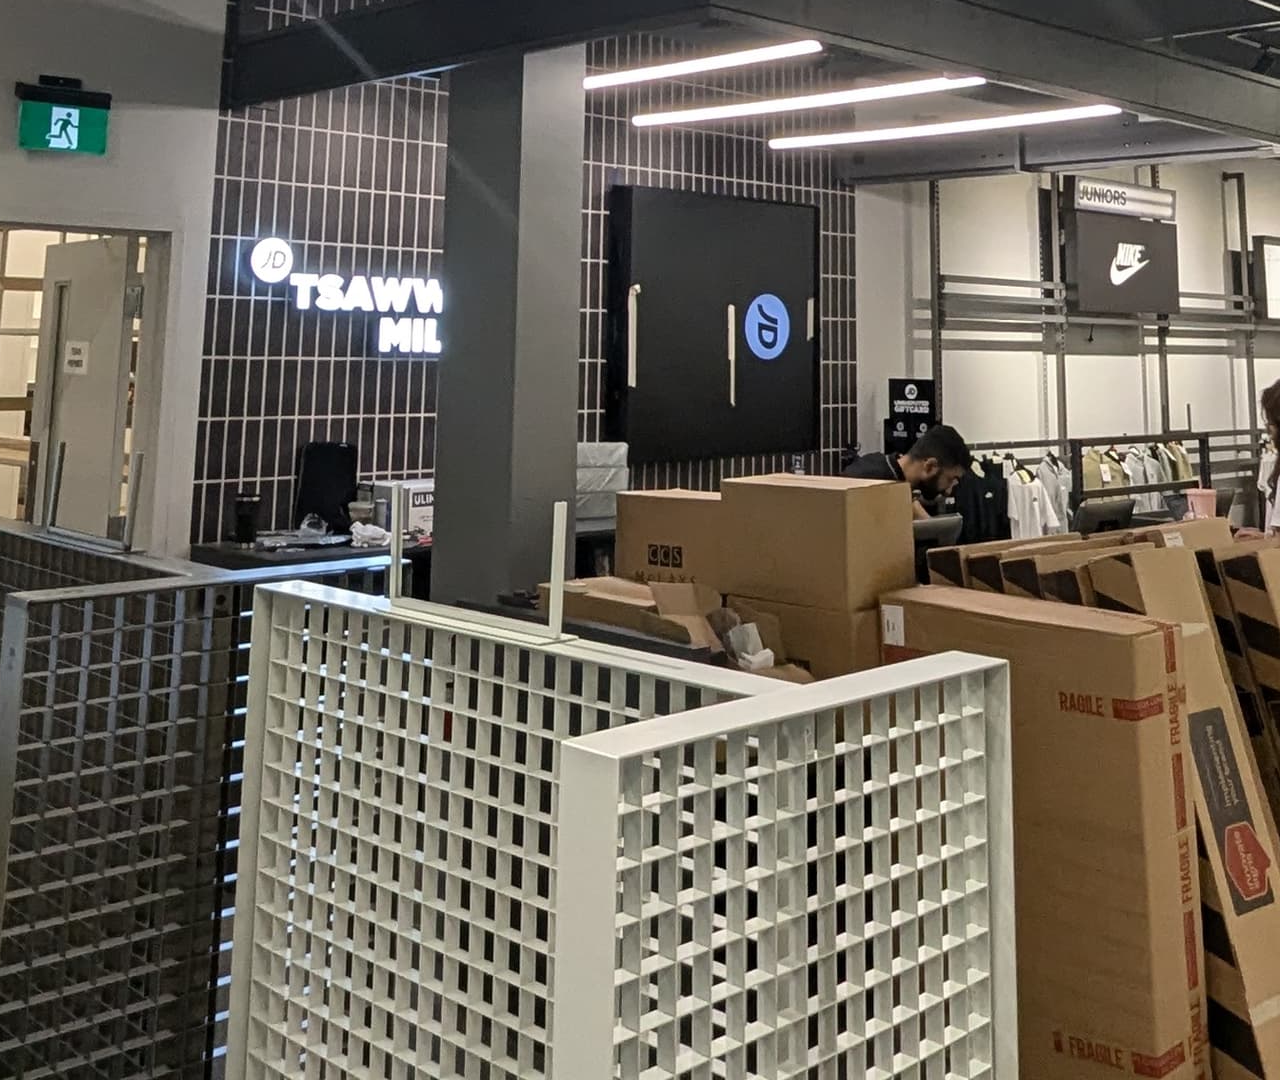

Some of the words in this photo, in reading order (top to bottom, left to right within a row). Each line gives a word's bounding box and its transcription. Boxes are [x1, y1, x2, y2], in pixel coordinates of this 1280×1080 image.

[1080, 185, 1127, 206] JUNIORS
[260, 249, 287, 269] JD
[1115, 242, 1145, 268] NIKE
[757, 303, 778, 350] JD
[648, 544, 682, 568] CCS
[1167, 681, 1181, 746] FRAGILE
[1178, 836, 1194, 905] FRAGILE
[1069, 1035, 1125, 1070] FRAGILE
